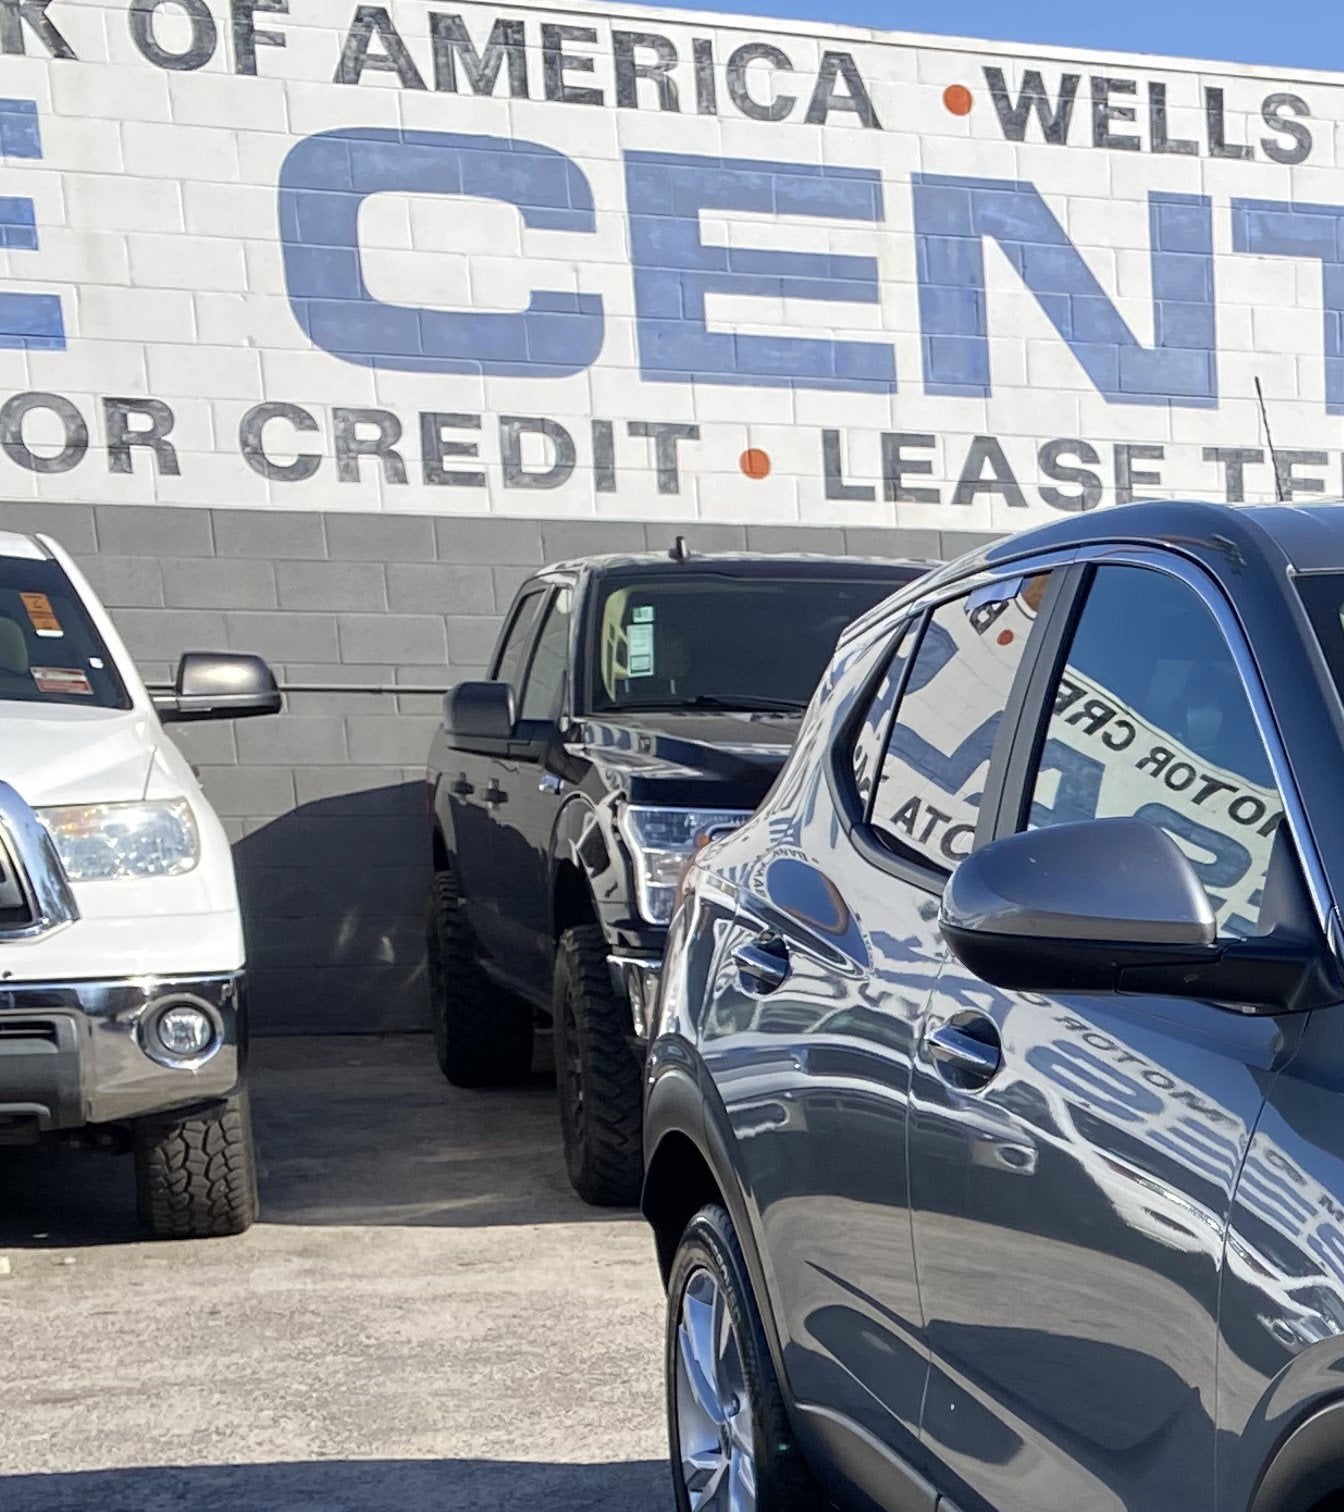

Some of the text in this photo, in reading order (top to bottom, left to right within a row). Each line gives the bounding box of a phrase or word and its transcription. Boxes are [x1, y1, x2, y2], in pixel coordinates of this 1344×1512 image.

[127, 0, 290, 75] OF
[332, 5, 883, 130] AMERICA
[983, 66, 1313, 165] WELLS
[0, 391, 700, 496] OR CREDIT
[822, 428, 1166, 512] LEASE
